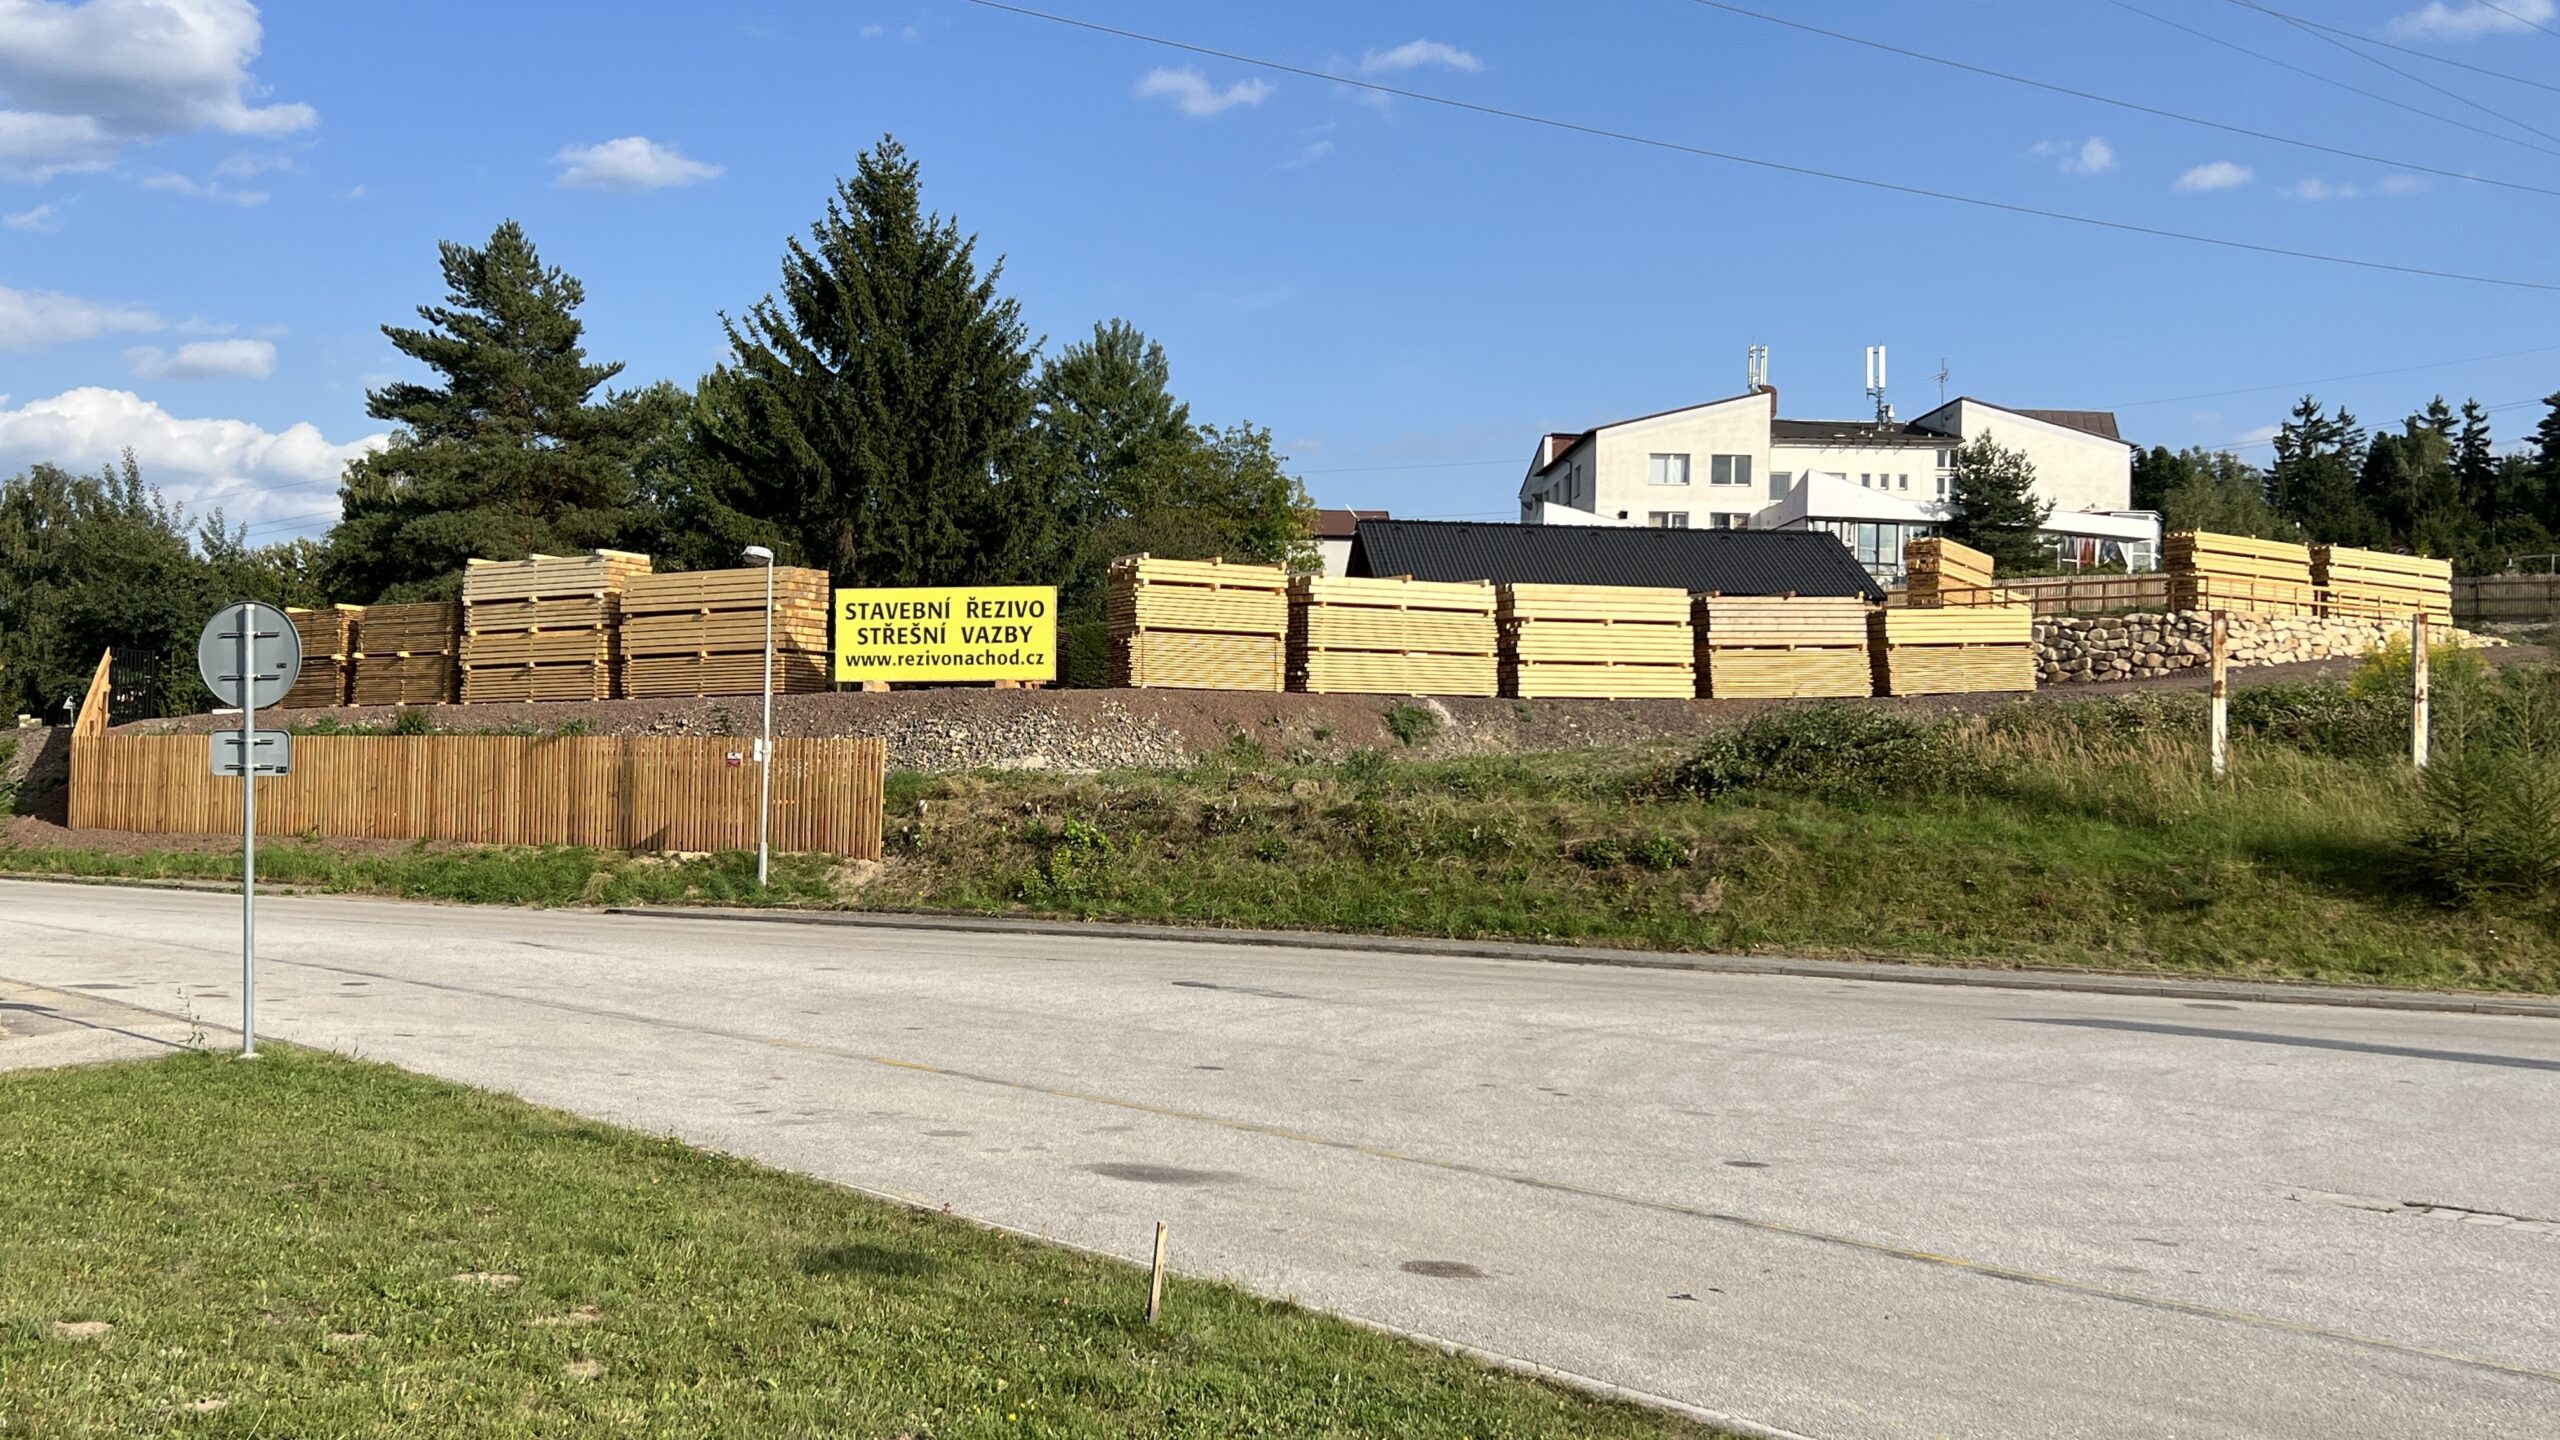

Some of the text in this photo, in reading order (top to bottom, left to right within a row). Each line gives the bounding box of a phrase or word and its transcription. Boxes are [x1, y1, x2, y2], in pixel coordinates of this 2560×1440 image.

[845, 597, 1045, 620] STAVEBNÍ ŘEZIVO
[857, 622, 1033, 645] STŘEŠNÍ VAZBY
[845, 649, 1045, 667] www.rezivonachod.cz
